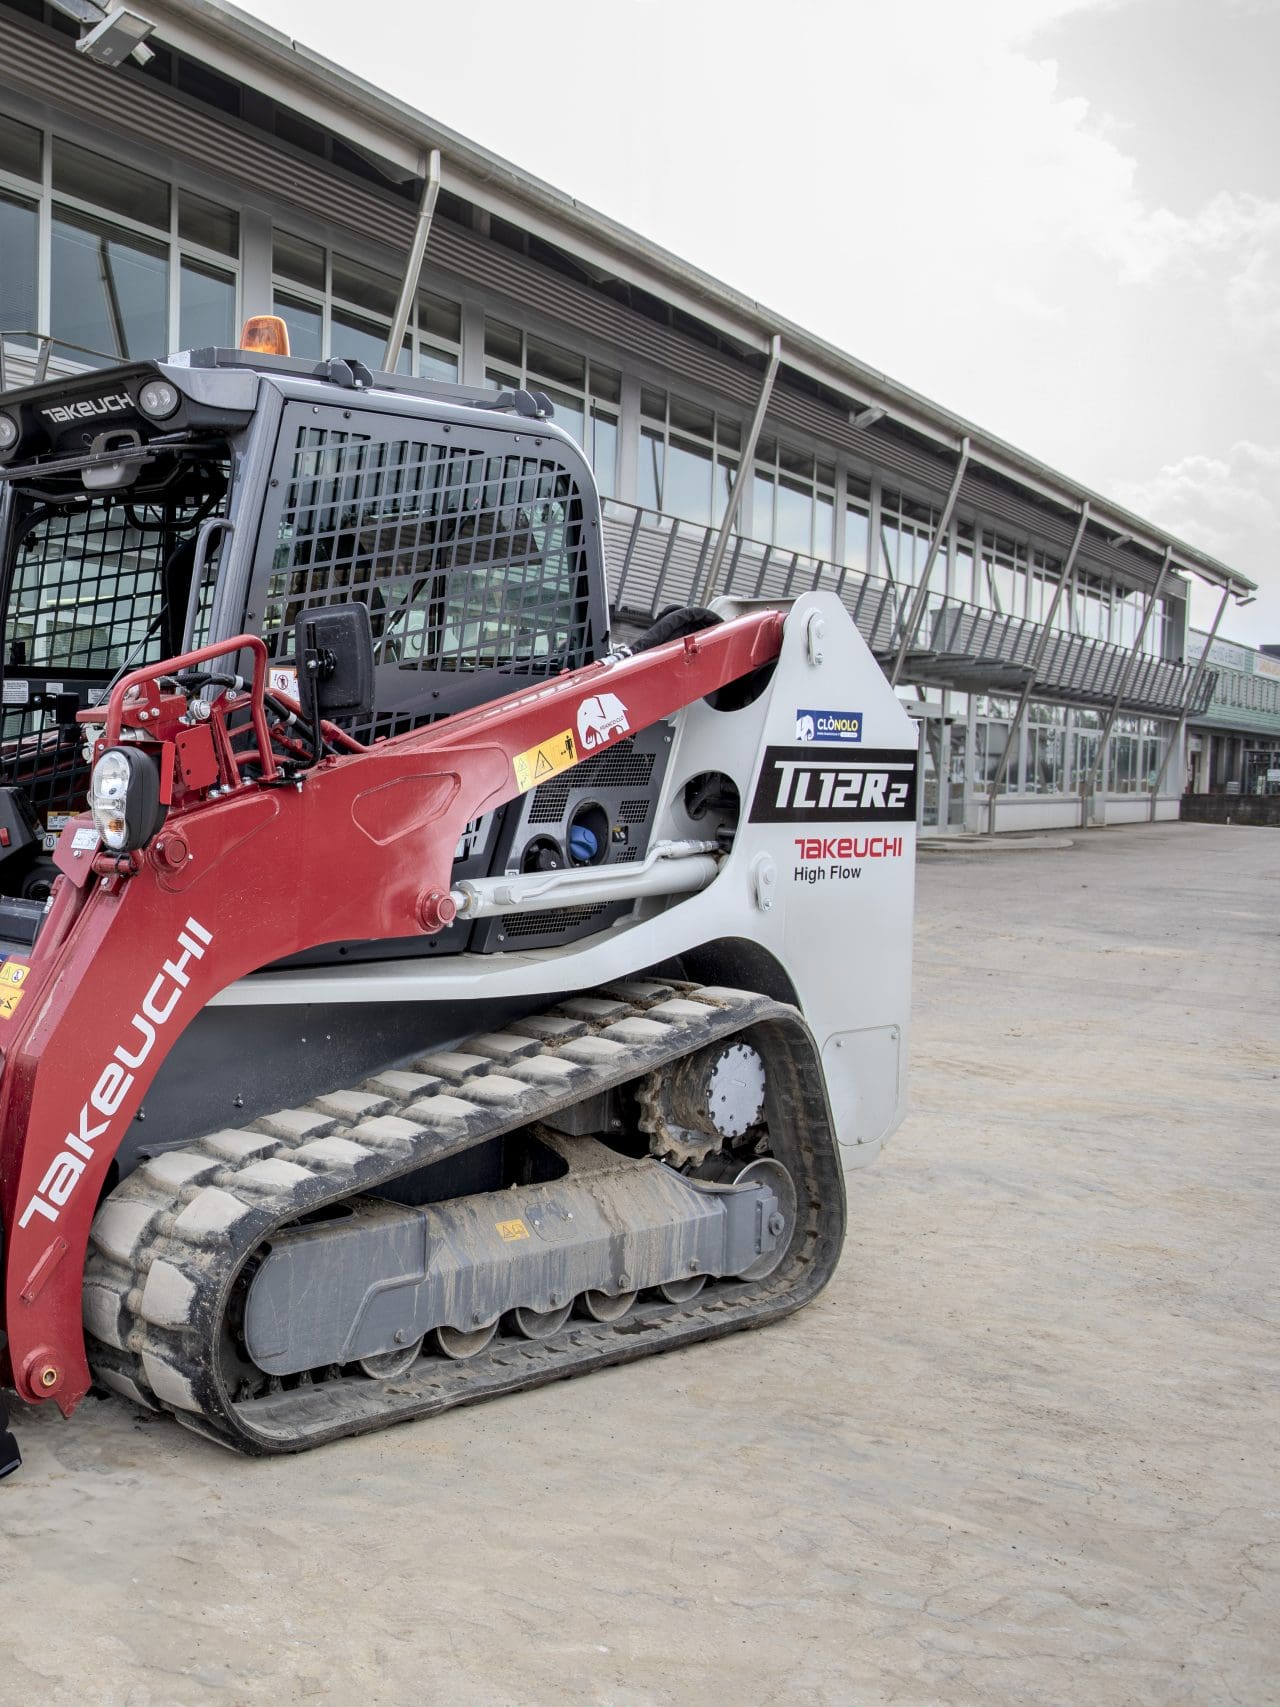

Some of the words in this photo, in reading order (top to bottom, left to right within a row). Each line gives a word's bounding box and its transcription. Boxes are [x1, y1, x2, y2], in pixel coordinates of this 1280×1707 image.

[817, 715, 859, 731] CLÒNOLO
[774, 760, 915, 808] TL12R2
[794, 837, 903, 860] TAKEUCHI
[794, 866, 825, 885] High
[830, 865, 862, 880] Flow
[18, 916, 213, 1229] TAKEUCHI
